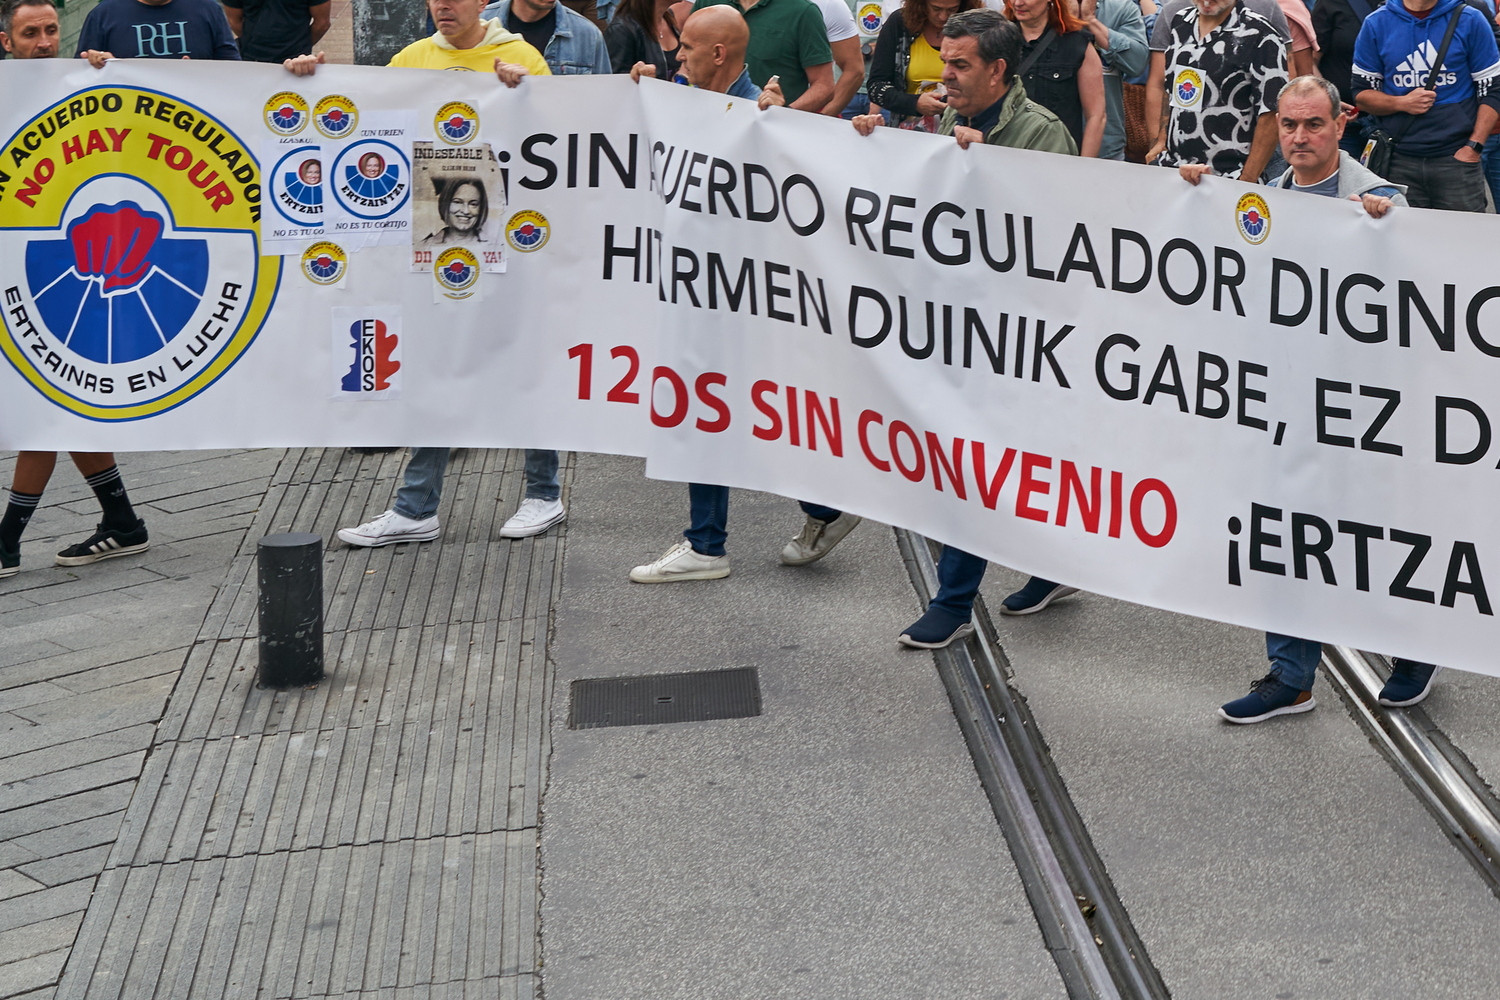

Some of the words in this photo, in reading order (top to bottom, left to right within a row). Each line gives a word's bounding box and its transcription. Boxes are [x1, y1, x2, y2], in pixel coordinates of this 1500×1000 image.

[10, 92, 123, 168] ACUERDO
[134, 95, 261, 224] REGULADOR
[14, 157, 55, 208] NO
[62, 127, 132, 165] HAY
[146, 133, 235, 213] TOUR
[378, 129, 404, 137] URIEN
[414, 148, 483, 160] INDESEABLE
[279, 192, 324, 214] ERTZAIN
[335, 222, 348, 230] NO
[350, 222, 360, 230] ES
[362, 221, 373, 229] TU
[341, 183, 405, 207] ERTZAINTZA
[845, 186, 1246, 318] REGULADOR
[5, 286, 114, 394] ERTZAINAS
[127, 366, 167, 393] EN
[172, 282, 242, 372] LUCHA
[362, 319, 375, 392] EKOS
[847, 284, 1076, 390] DUINIK
[1095, 333, 1287, 447] GABE,
[1315, 377, 1404, 457] EZ
[750, 379, 845, 459] SIN
[857, 408, 1179, 549] CONVENIO
